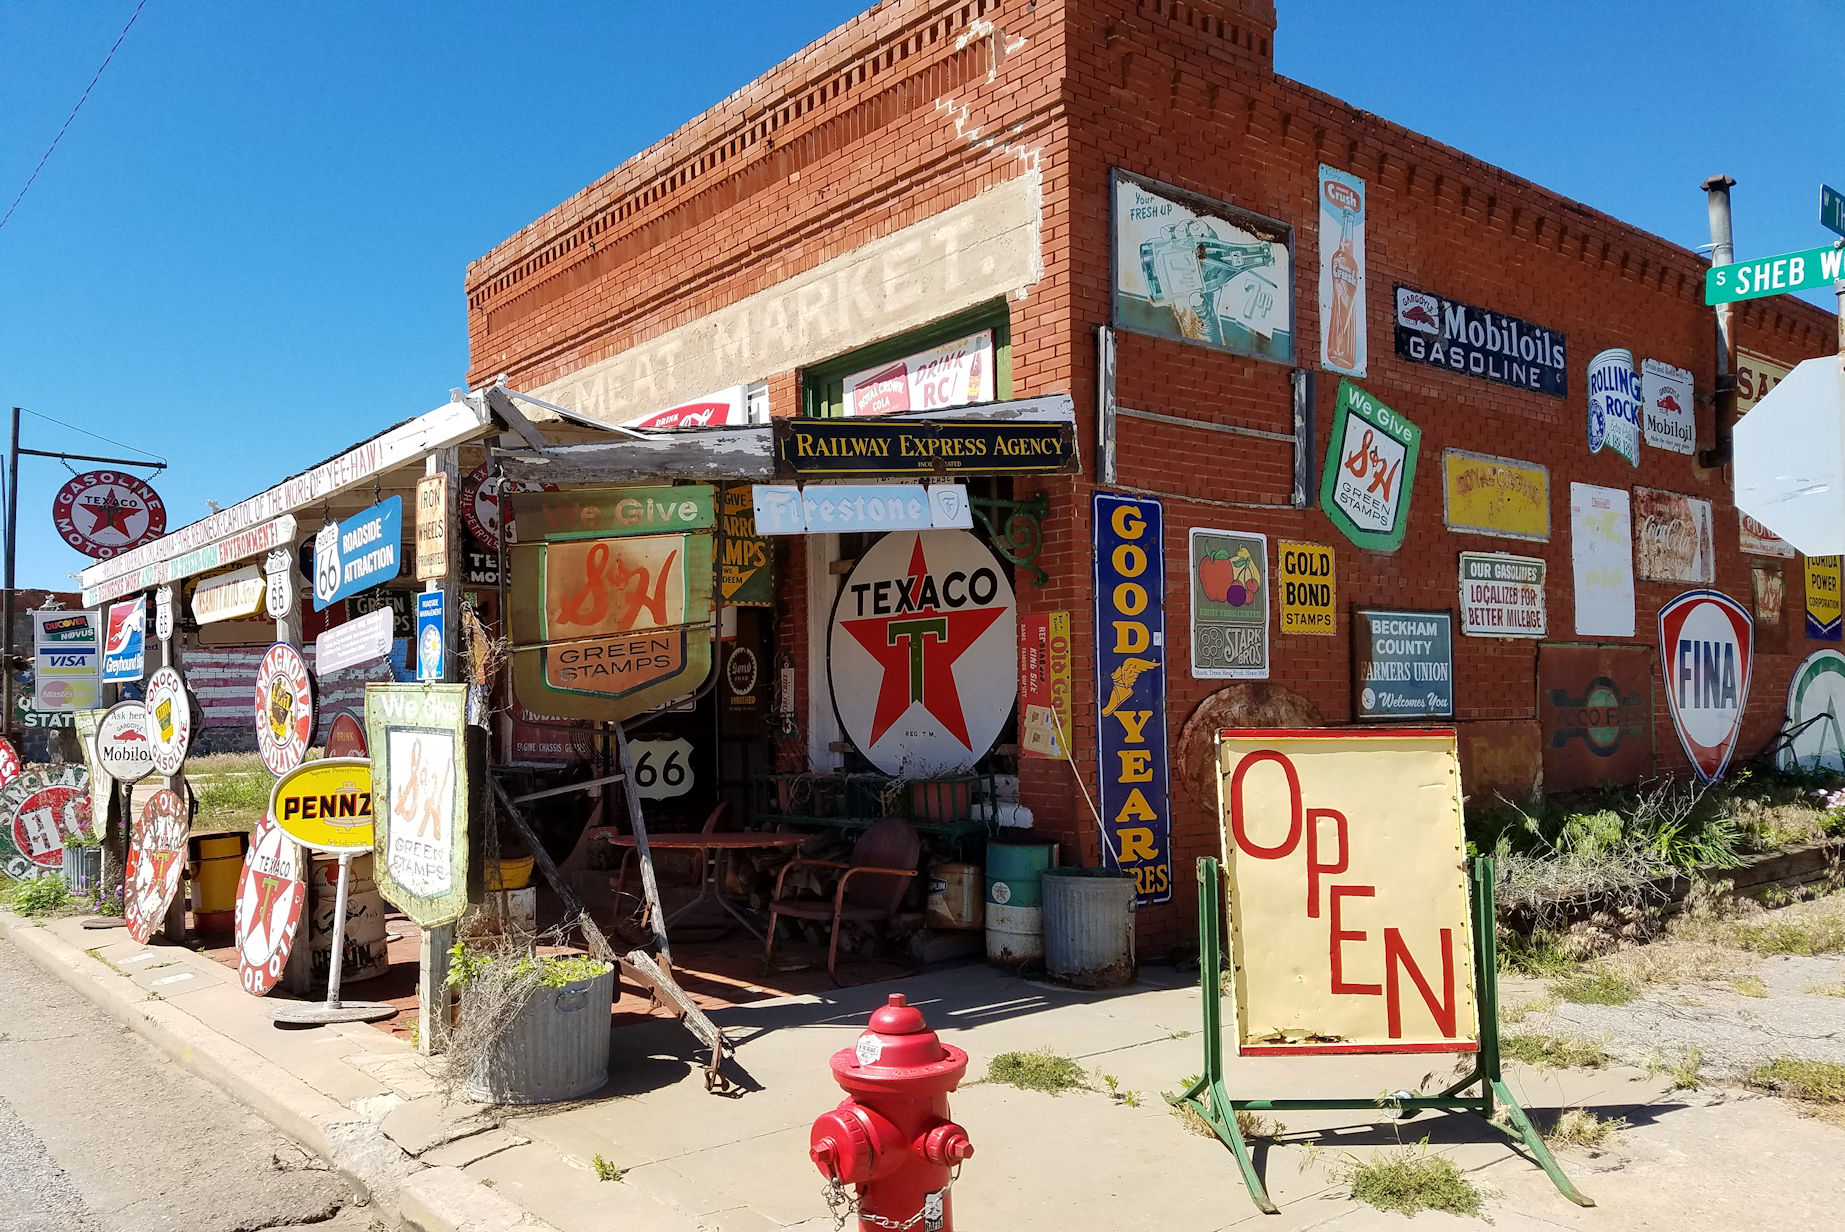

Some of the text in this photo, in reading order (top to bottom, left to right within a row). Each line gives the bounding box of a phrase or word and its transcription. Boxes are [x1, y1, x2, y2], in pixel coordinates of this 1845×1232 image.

[1135, 192, 1155, 205] Your
[1327, 183, 1357, 208] Crush
[1130, 204, 1173, 222] FRESH UP
[1716, 257, 1805, 294] S SHEB
[1402, 294, 1434, 313] GARGOYLE
[1443, 301, 1565, 370] Mobiloils
[915, 350, 966, 385] DRINK
[1409, 336, 1541, 389] GASOLINE
[570, 340, 683, 418] MEAT
[1591, 366, 1641, 402] ROLLING
[858, 385, 879, 411] ROYAL
[878, 378, 906, 395] CROWN
[871, 397, 891, 411] COLA
[1659, 386, 1680, 401] GARGOYLE
[655, 413, 679, 426] DRINK
[1349, 387, 1413, 441] We Give
[1605, 395, 1643, 432] ROCK
[1647, 414, 1692, 442] Mobiloil
[797, 433, 1063, 457] RAILWAY EXPRESS AGENCY
[59, 472, 162, 511] GASOLINE
[1456, 467, 1495, 496] ROYAL
[84, 495, 138, 507] TEXACO
[255, 496, 265, 521] OF
[267, 490, 282, 514] THE
[420, 487, 441, 510] IRON
[463, 487, 473, 507] THE
[724, 491, 748, 506] GIVE
[764, 490, 922, 523] Firestone
[1339, 492, 1389, 526] STAMPS
[1342, 482, 1391, 515] GREEN
[541, 498, 699, 528] We Give
[317, 527, 336, 547] ROUTE
[342, 518, 383, 555] ROADSIDE
[418, 519, 444, 543] WHEELS
[125, 572, 141, 592] WORK
[141, 568, 153, 587] AND
[218, 522, 279, 562] ENVIRONMENT!
[343, 544, 394, 585] ATTRACTION
[418, 551, 445, 566] PROHIBITED
[1284, 551, 1330, 577] GOLD
[318, 548, 338, 596] 66
[713, 575, 743, 585] RDEEM
[1470, 561, 1538, 580] OUR GASOLINES
[1811, 574, 1837, 592] POWER
[271, 586, 285, 611] 66
[555, 543, 679, 633] S&H
[850, 567, 998, 617] TEXACO
[1285, 581, 1331, 608] BOND
[1470, 582, 1537, 607] LOCALIZED FOR
[1808, 596, 1839, 610] CORPORATION
[44, 616, 87, 631] DISCOVER
[159, 614, 168, 635] 66
[1286, 613, 1331, 626] STAMPS
[1371, 619, 1438, 636] BECKHAM
[1468, 606, 1542, 629] BETTER MILEAGE
[60, 628, 94, 640] NOVUS
[1224, 627, 1262, 664] STARK
[1375, 639, 1432, 655] COUNTY
[50, 655, 87, 667] VISA
[559, 637, 670, 664] GREEN
[1029, 647, 1038, 672] KING
[1050, 635, 1067, 674] Old
[1237, 643, 1262, 665] BROS
[106, 655, 137, 676] Greyhound
[559, 655, 672, 682] STAMPS
[1360, 661, 1449, 682] FARMERS UNION
[1678, 639, 1738, 709] FINA
[147, 672, 179, 715] CONOCO
[257, 646, 310, 719] MAGNOLIA
[381, 694, 459, 721] We Give
[1378, 691, 1449, 711] Welcomes You
[111, 711, 127, 721] Ask
[117, 723, 143, 732] GARGOYLE
[152, 719, 188, 771] GASOLINE
[257, 709, 306, 774] GASOLINE
[336, 731, 354, 741] DRINK
[634, 750, 683, 790] 66
[394, 836, 444, 863] GREEN
[260, 855, 291, 878] TEXACO
[392, 855, 446, 881] STAMPS
[1230, 749, 1457, 1039] OPEN
[268, 919, 297, 977] OIL
